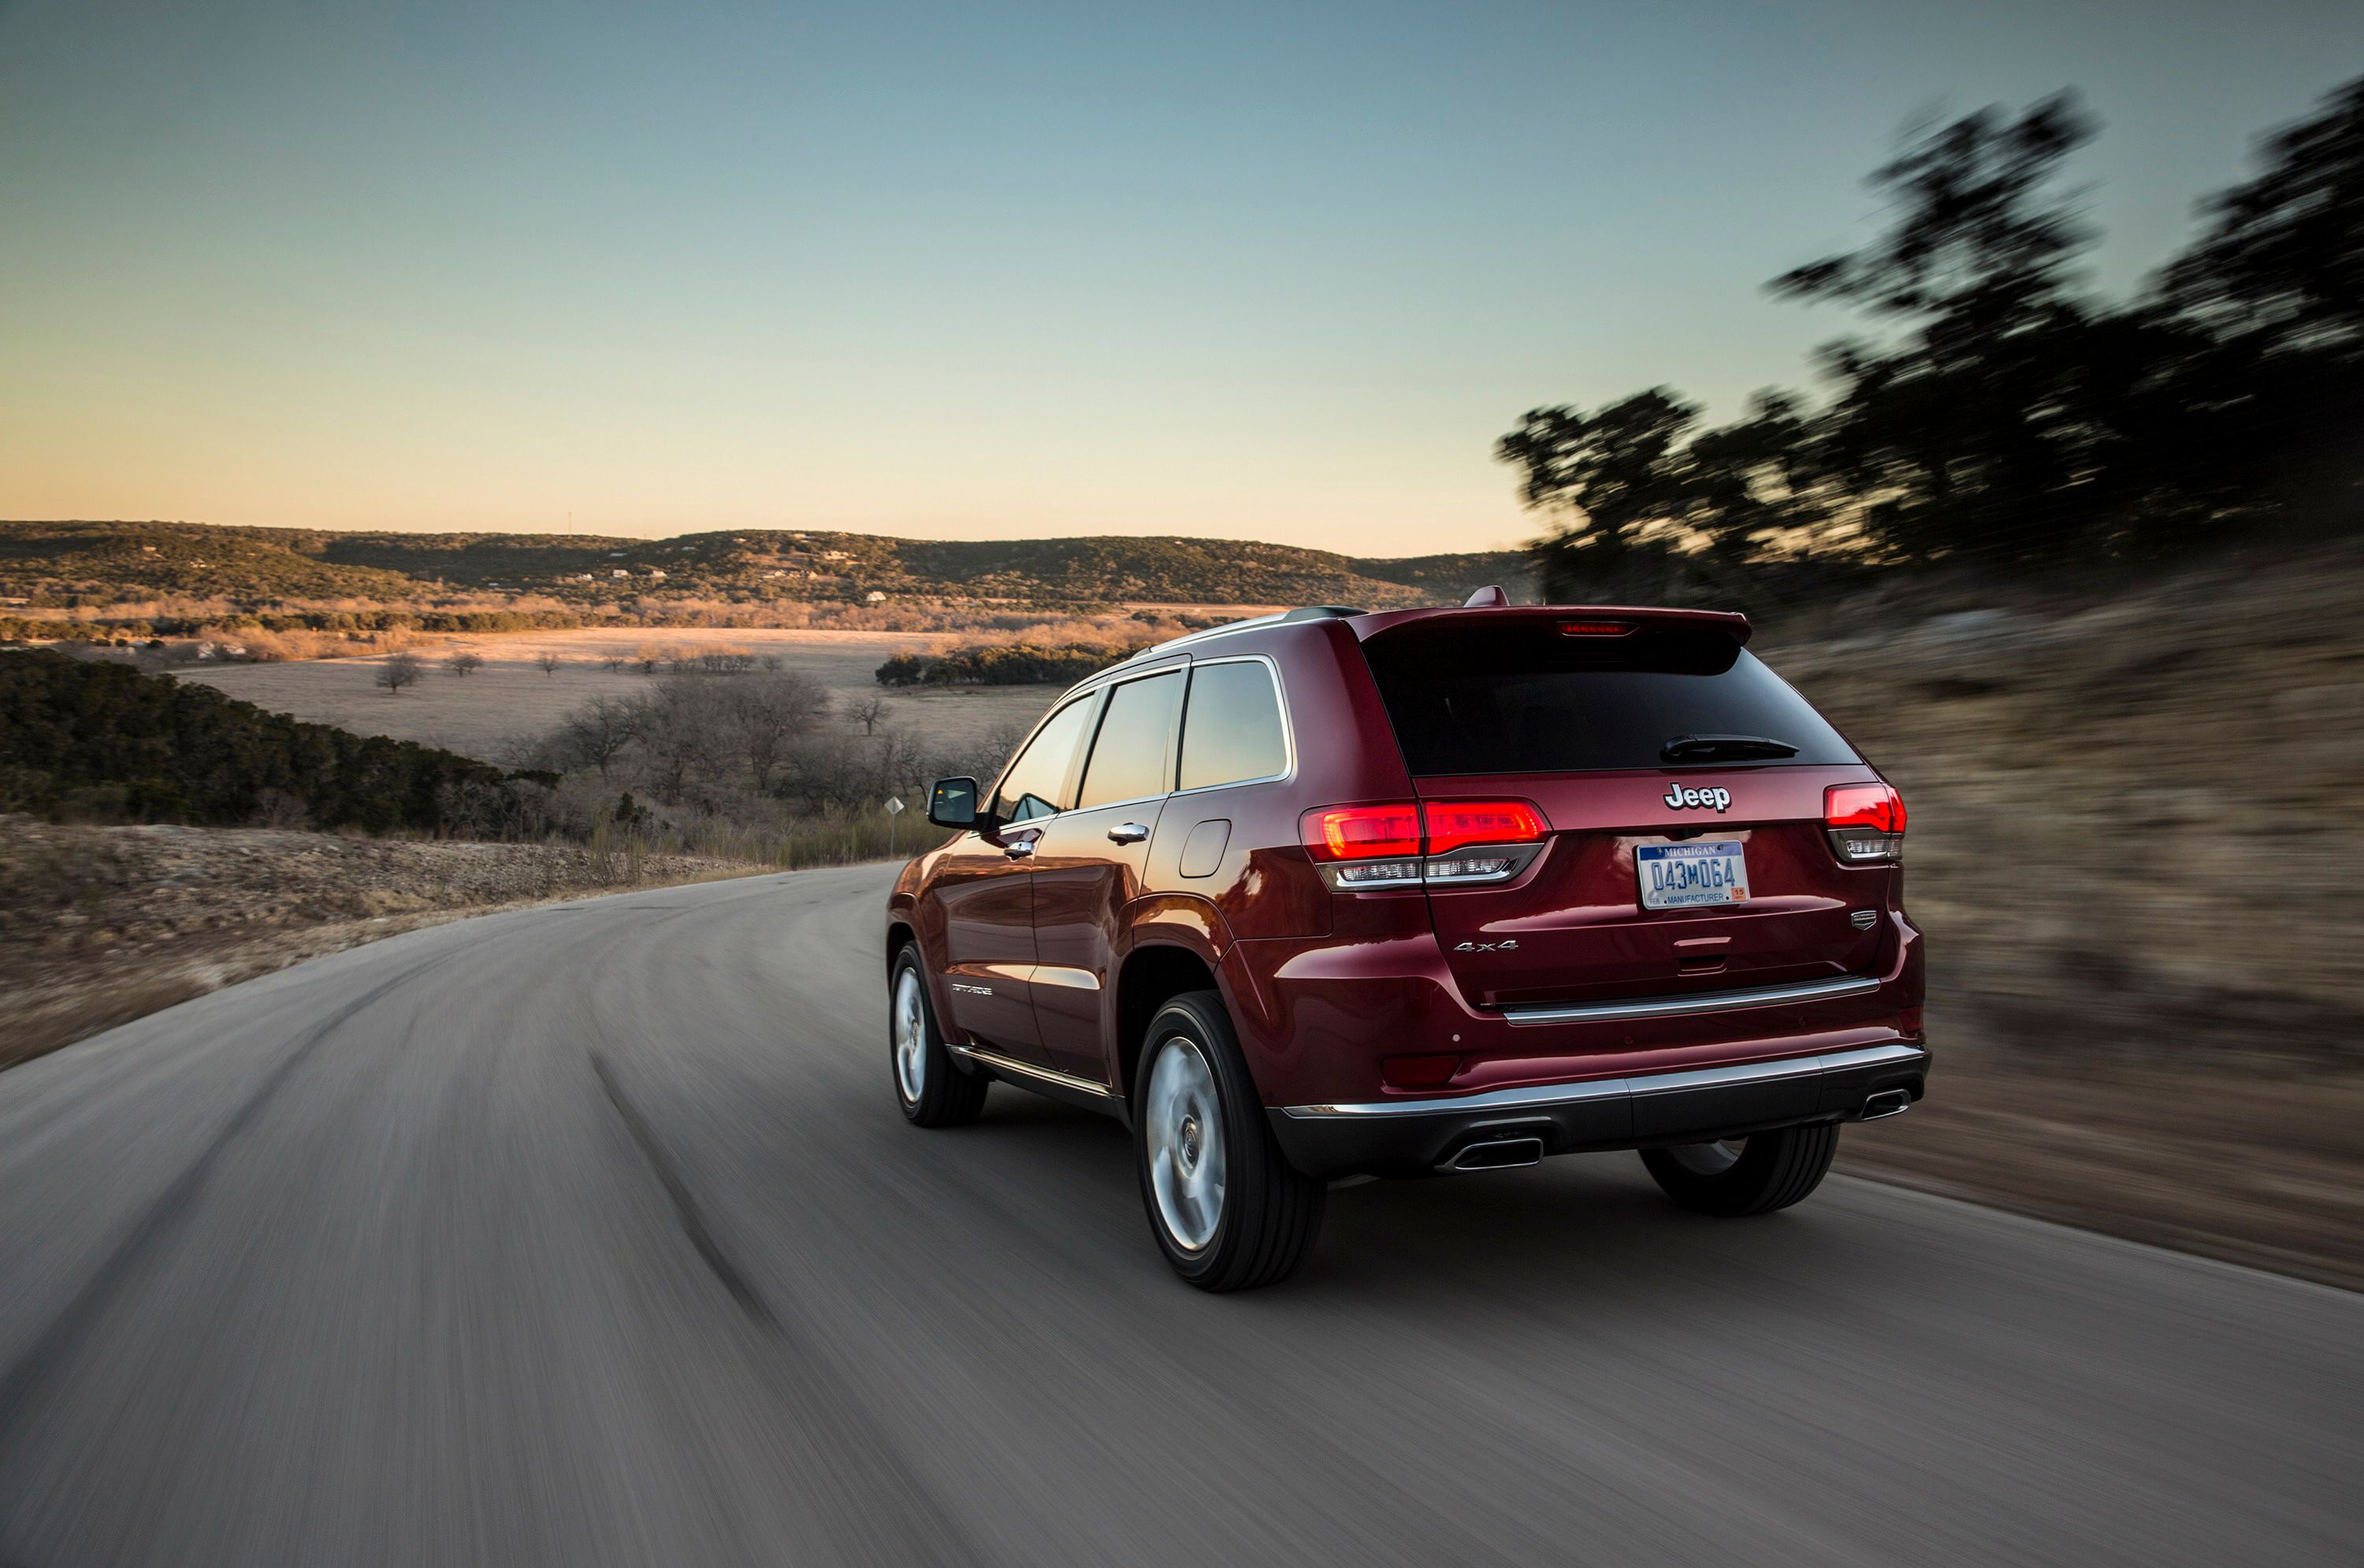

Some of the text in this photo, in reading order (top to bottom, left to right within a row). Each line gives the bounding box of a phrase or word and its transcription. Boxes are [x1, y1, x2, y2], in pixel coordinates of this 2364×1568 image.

[1663, 782, 1731, 812] Jeep
[1664, 845, 1716, 857] MICHIGAN
[1651, 858, 1735, 890] 043M064
[1667, 893, 1724, 905] MANUFACTURER
[1453, 940, 1519, 953] 4x4
